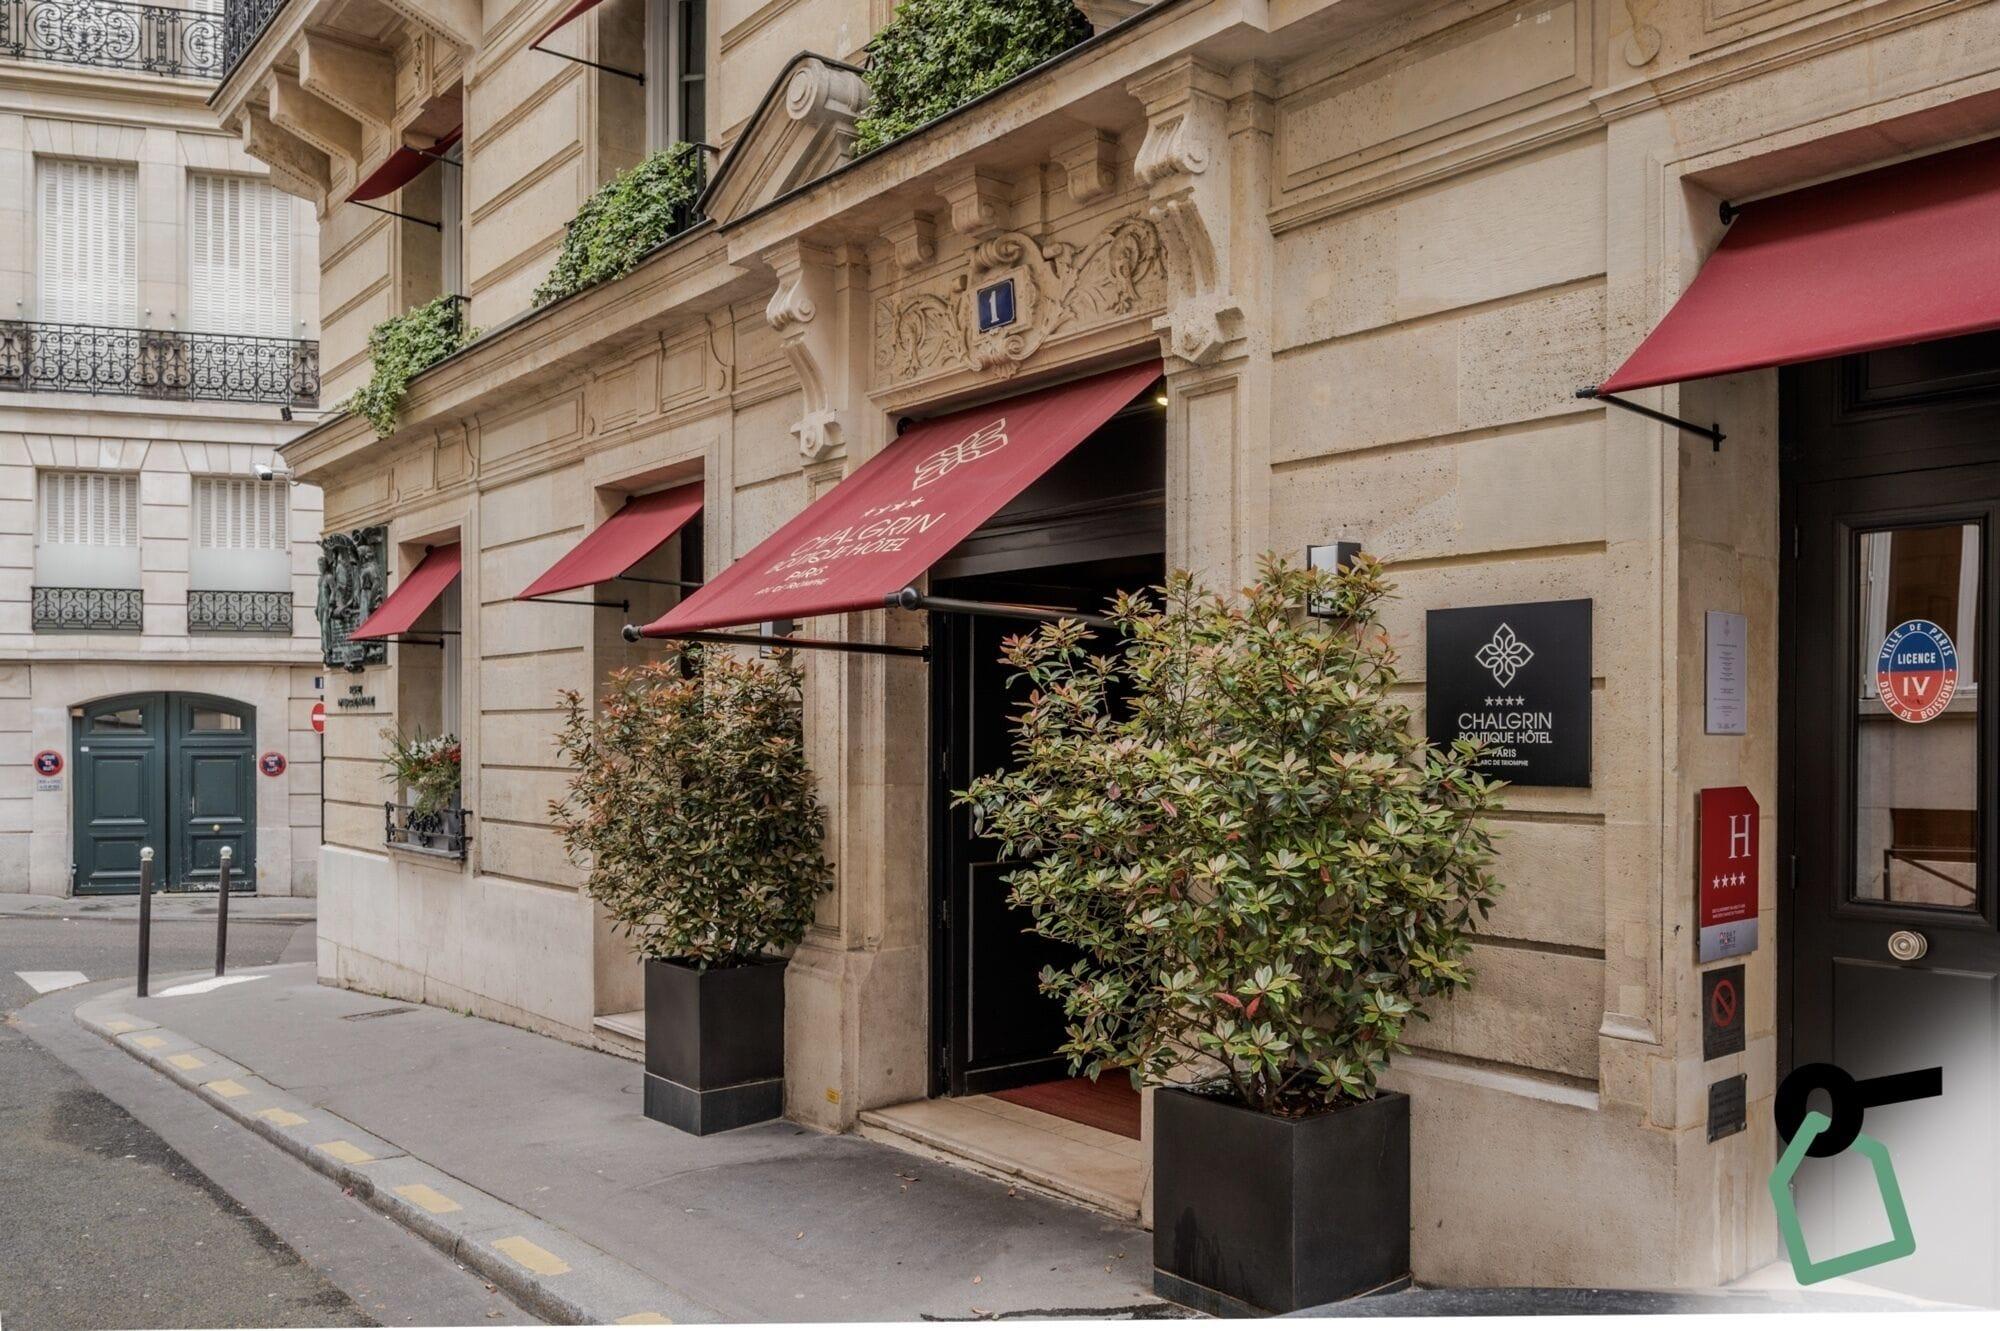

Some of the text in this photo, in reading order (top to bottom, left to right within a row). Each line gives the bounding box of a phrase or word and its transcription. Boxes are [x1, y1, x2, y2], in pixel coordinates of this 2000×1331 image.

[988, 290, 1000, 324] 1
[790, 512, 947, 558] CHALGRIN
[1880, 622, 1954, 660] VILLE DE PARIS
[1897, 651, 1936, 665] LICENCE
[1879, 679, 1955, 720] DEBIT DE BOISSONS
[1903, 676, 1931, 697] IV
[1458, 711, 1553, 730] CHALGRIN
[1516, 729, 1553, 744] HÔTEL
[1492, 759, 1501, 767] DE
[1728, 813, 1752, 859] H
